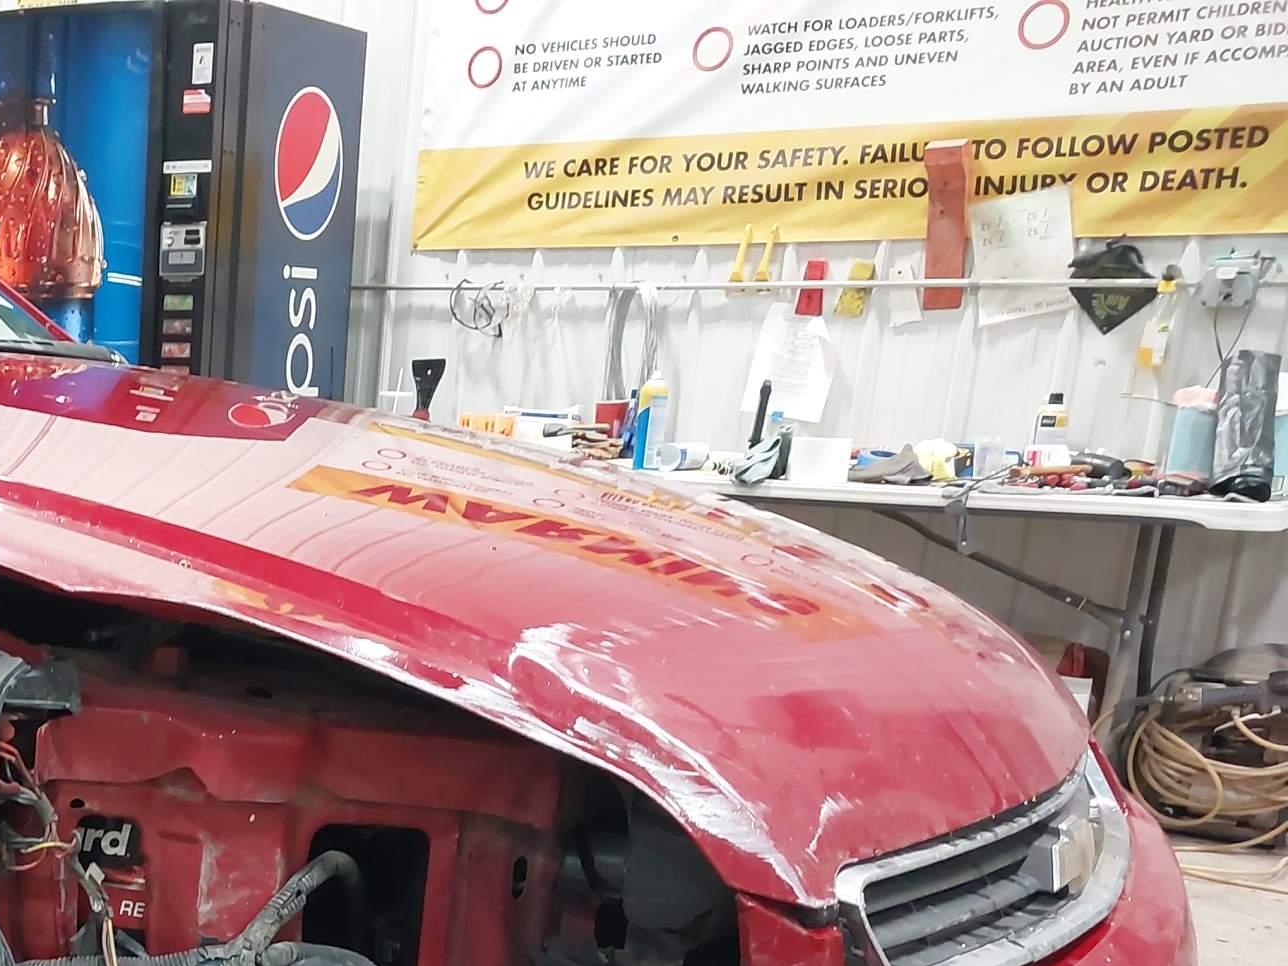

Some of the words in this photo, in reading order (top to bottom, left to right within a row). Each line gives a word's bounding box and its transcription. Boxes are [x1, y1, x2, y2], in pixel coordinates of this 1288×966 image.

[748, 21, 798, 36] WATCH
[803, 19, 832, 32] FOR
[838, 6, 1000, 30] LOADERS/FORKLIFTS,
[1082, 15, 1120, 31] NOT
[1125, 8, 1190, 26] PERMIT
[1196, 0, 1288, 19] CHILDREN
[515, 44, 536, 55] NO
[542, 38, 598, 54] VEHICLES
[602, 33, 656, 48] SHOULD
[744, 41, 803, 56] JAGGED
[808, 38, 858, 52] EDGES,
[864, 33, 912, 48] LOOSE
[918, 29, 969, 44] PARTS,
[1077, 33, 1159, 53] AUCTION
[1166, 28, 1214, 45] YARD
[1220, 25, 1248, 40] OR
[1254, 22, 1288, 37] BID
[514, 62, 528, 74] BE
[532, 58, 578, 73] DRIVEN
[584, 56, 601, 68] OR
[606, 52, 662, 66] STARTED
[742, 61, 792, 76] SHARP
[796, 57, 849, 72] POINTS
[854, 54, 888, 68] AND
[894, 50, 958, 66] UNEVEN
[1072, 59, 1124, 75] AREA,
[1130, 54, 1178, 70] EVEN
[1184, 51, 1200, 66] IF
[1204, 44, 1288, 63] ACCOMP
[512, 80, 528, 92] AT
[531, 76, 587, 90] ANYTIME
[740, 79, 810, 95] WALKING
[814, 74, 886, 91] SURFACES
[1068, 82, 1091, 96] BY
[1096, 80, 1124, 94] AN
[1129, 75, 1188, 92] ADULT
[524, 160, 556, 180] WE
[562, 156, 620, 178] CARE
[627, 154, 674, 176] FOR
[681, 151, 748, 172] YOUR
[756, 145, 850, 170] SAFETY.
[859, 141, 929, 164] FAILU
[973, 138, 1007, 160] TO
[1016, 133, 1138, 159] FOLLOW
[1148, 124, 1270, 154] POSTED
[526, 186, 654, 211] GUIDELINES
[662, 185, 716, 207] MAY
[722, 182, 808, 206] RESULT
[816, 180, 845, 201] IN
[854, 177, 928, 199] SERIO
[1086, 172, 1129, 194] OR
[1139, 166, 1248, 192] DEATH.
